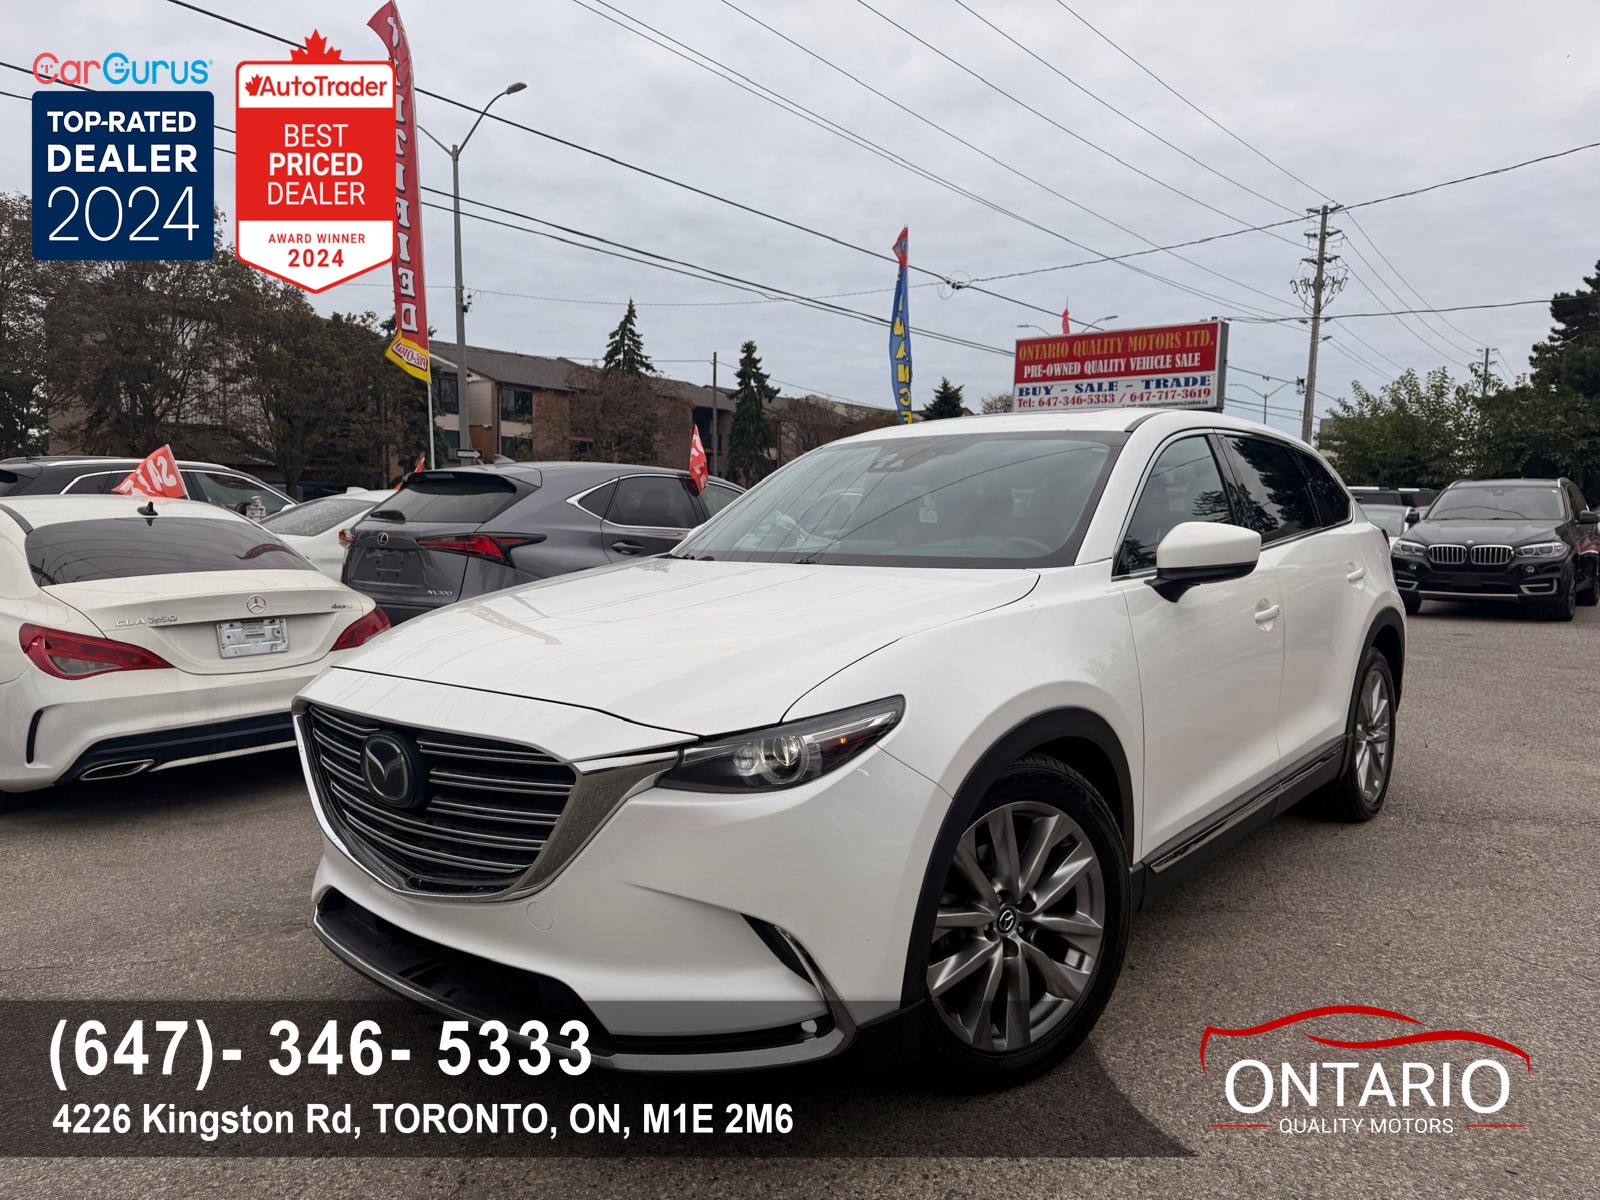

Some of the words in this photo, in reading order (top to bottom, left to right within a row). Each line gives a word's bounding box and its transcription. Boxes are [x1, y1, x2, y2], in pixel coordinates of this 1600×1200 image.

[1019, 341, 1069, 361] ONTARIO
[1073, 336, 1124, 358] QUALITY
[1128, 331, 1181, 353] MOTORS
[1185, 329, 1214, 347] LTD.
[1023, 361, 1081, 379] PRE-OWNED
[1084, 357, 1127, 375] QUALITY
[1129, 354, 1172, 371] VEHICLE
[1175, 352, 1200, 368] SALE
[1018, 384, 1054, 397] BUY
[1074, 381, 1118, 394] SALE
[1141, 375, 1211, 390] TRADE
[1017, 398, 1035, 408] Tel:
[1038, 393, 1115, 407] 647-346-5333
[1130, 388, 1211, 402] 647-717-3619
[115, 617, 147, 628] CLA
